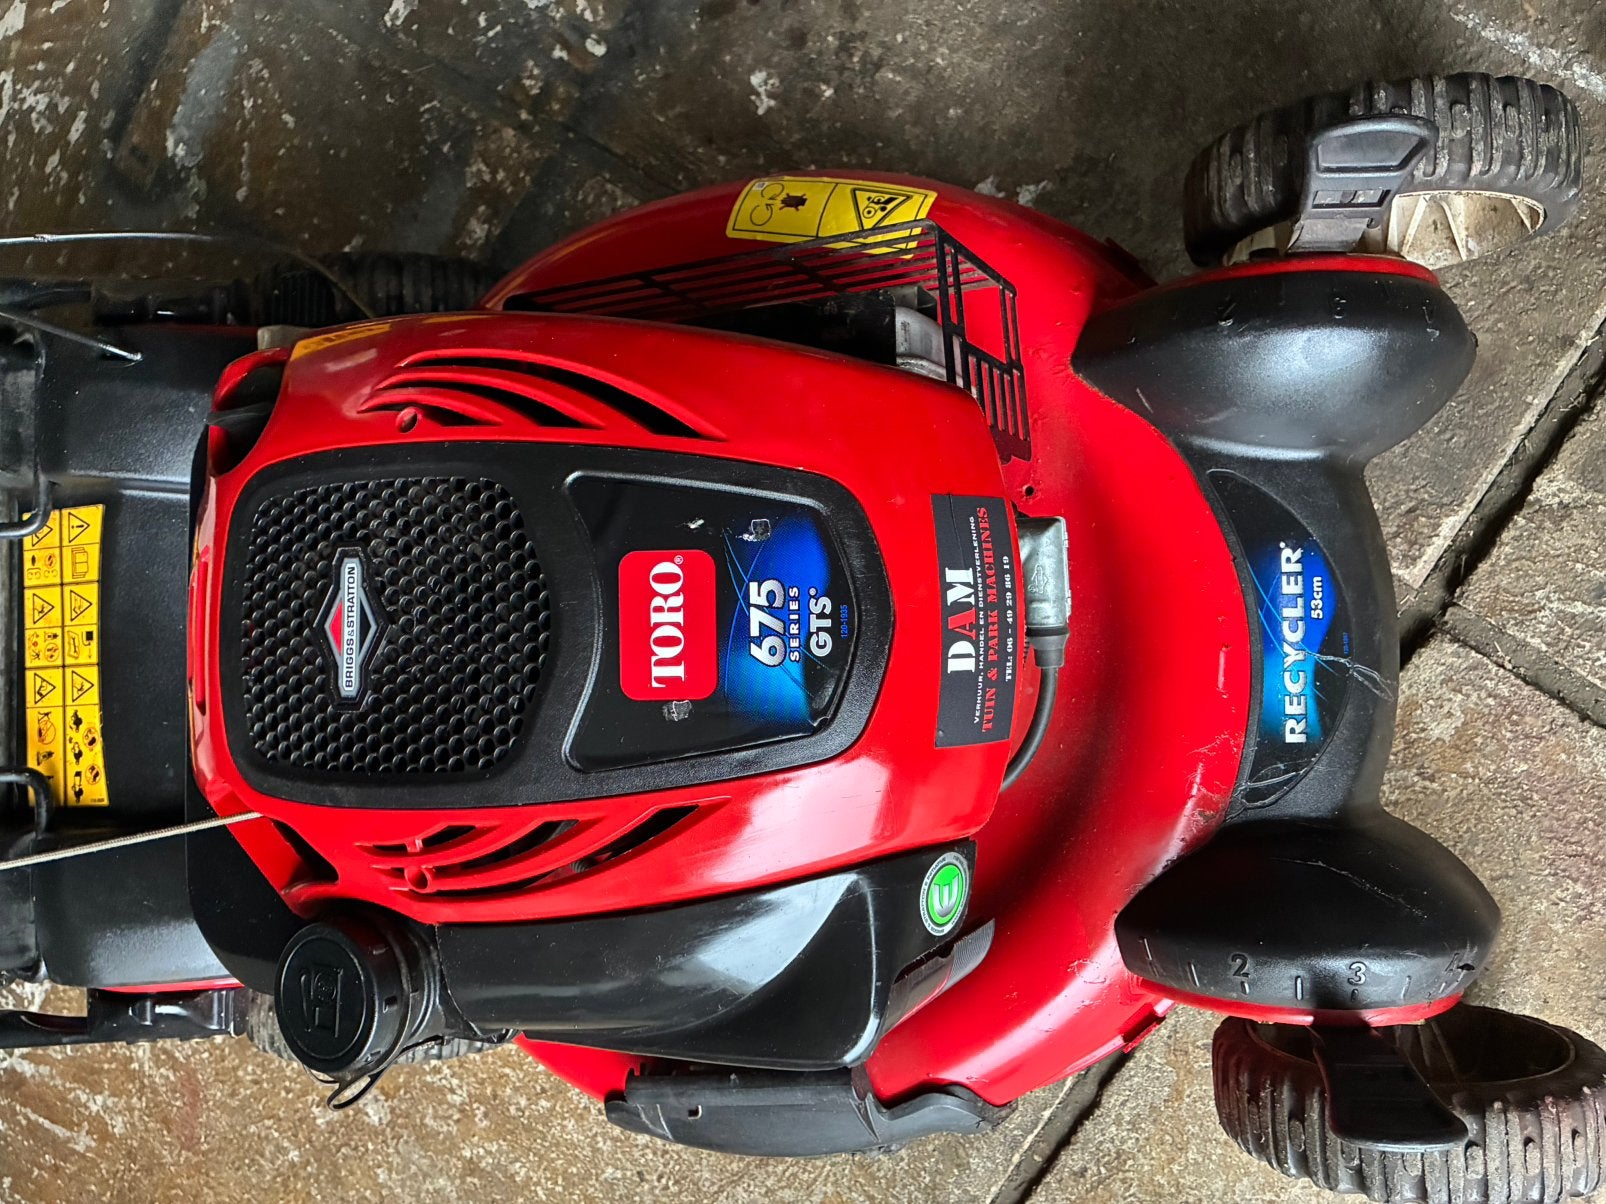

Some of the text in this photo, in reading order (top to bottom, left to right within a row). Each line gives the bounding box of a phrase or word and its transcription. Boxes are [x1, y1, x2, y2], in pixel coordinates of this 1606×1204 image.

[969, 516, 984, 608] DIENSTVERLENING
[1002, 555, 1010, 569] 19
[1004, 574, 1011, 588] 86
[1005, 592, 1012, 606] 29
[1310, 576, 1323, 619] 53cm
[749, 578, 787, 667] 675
[789, 585, 800, 662] SERIES
[945, 567, 976, 673] DAM
[977, 506, 998, 732] TUIN & PARK MACHINES
[979, 611, 985, 624] EN
[1005, 610, 1013, 624] 49
[1007, 638, 1013, 652] 06
[1005, 657, 1013, 682] TEL:
[973, 672, 984, 724] VERHUUR,
[1229, 952, 1250, 978] 2
[1346, 960, 1367, 986] 3
